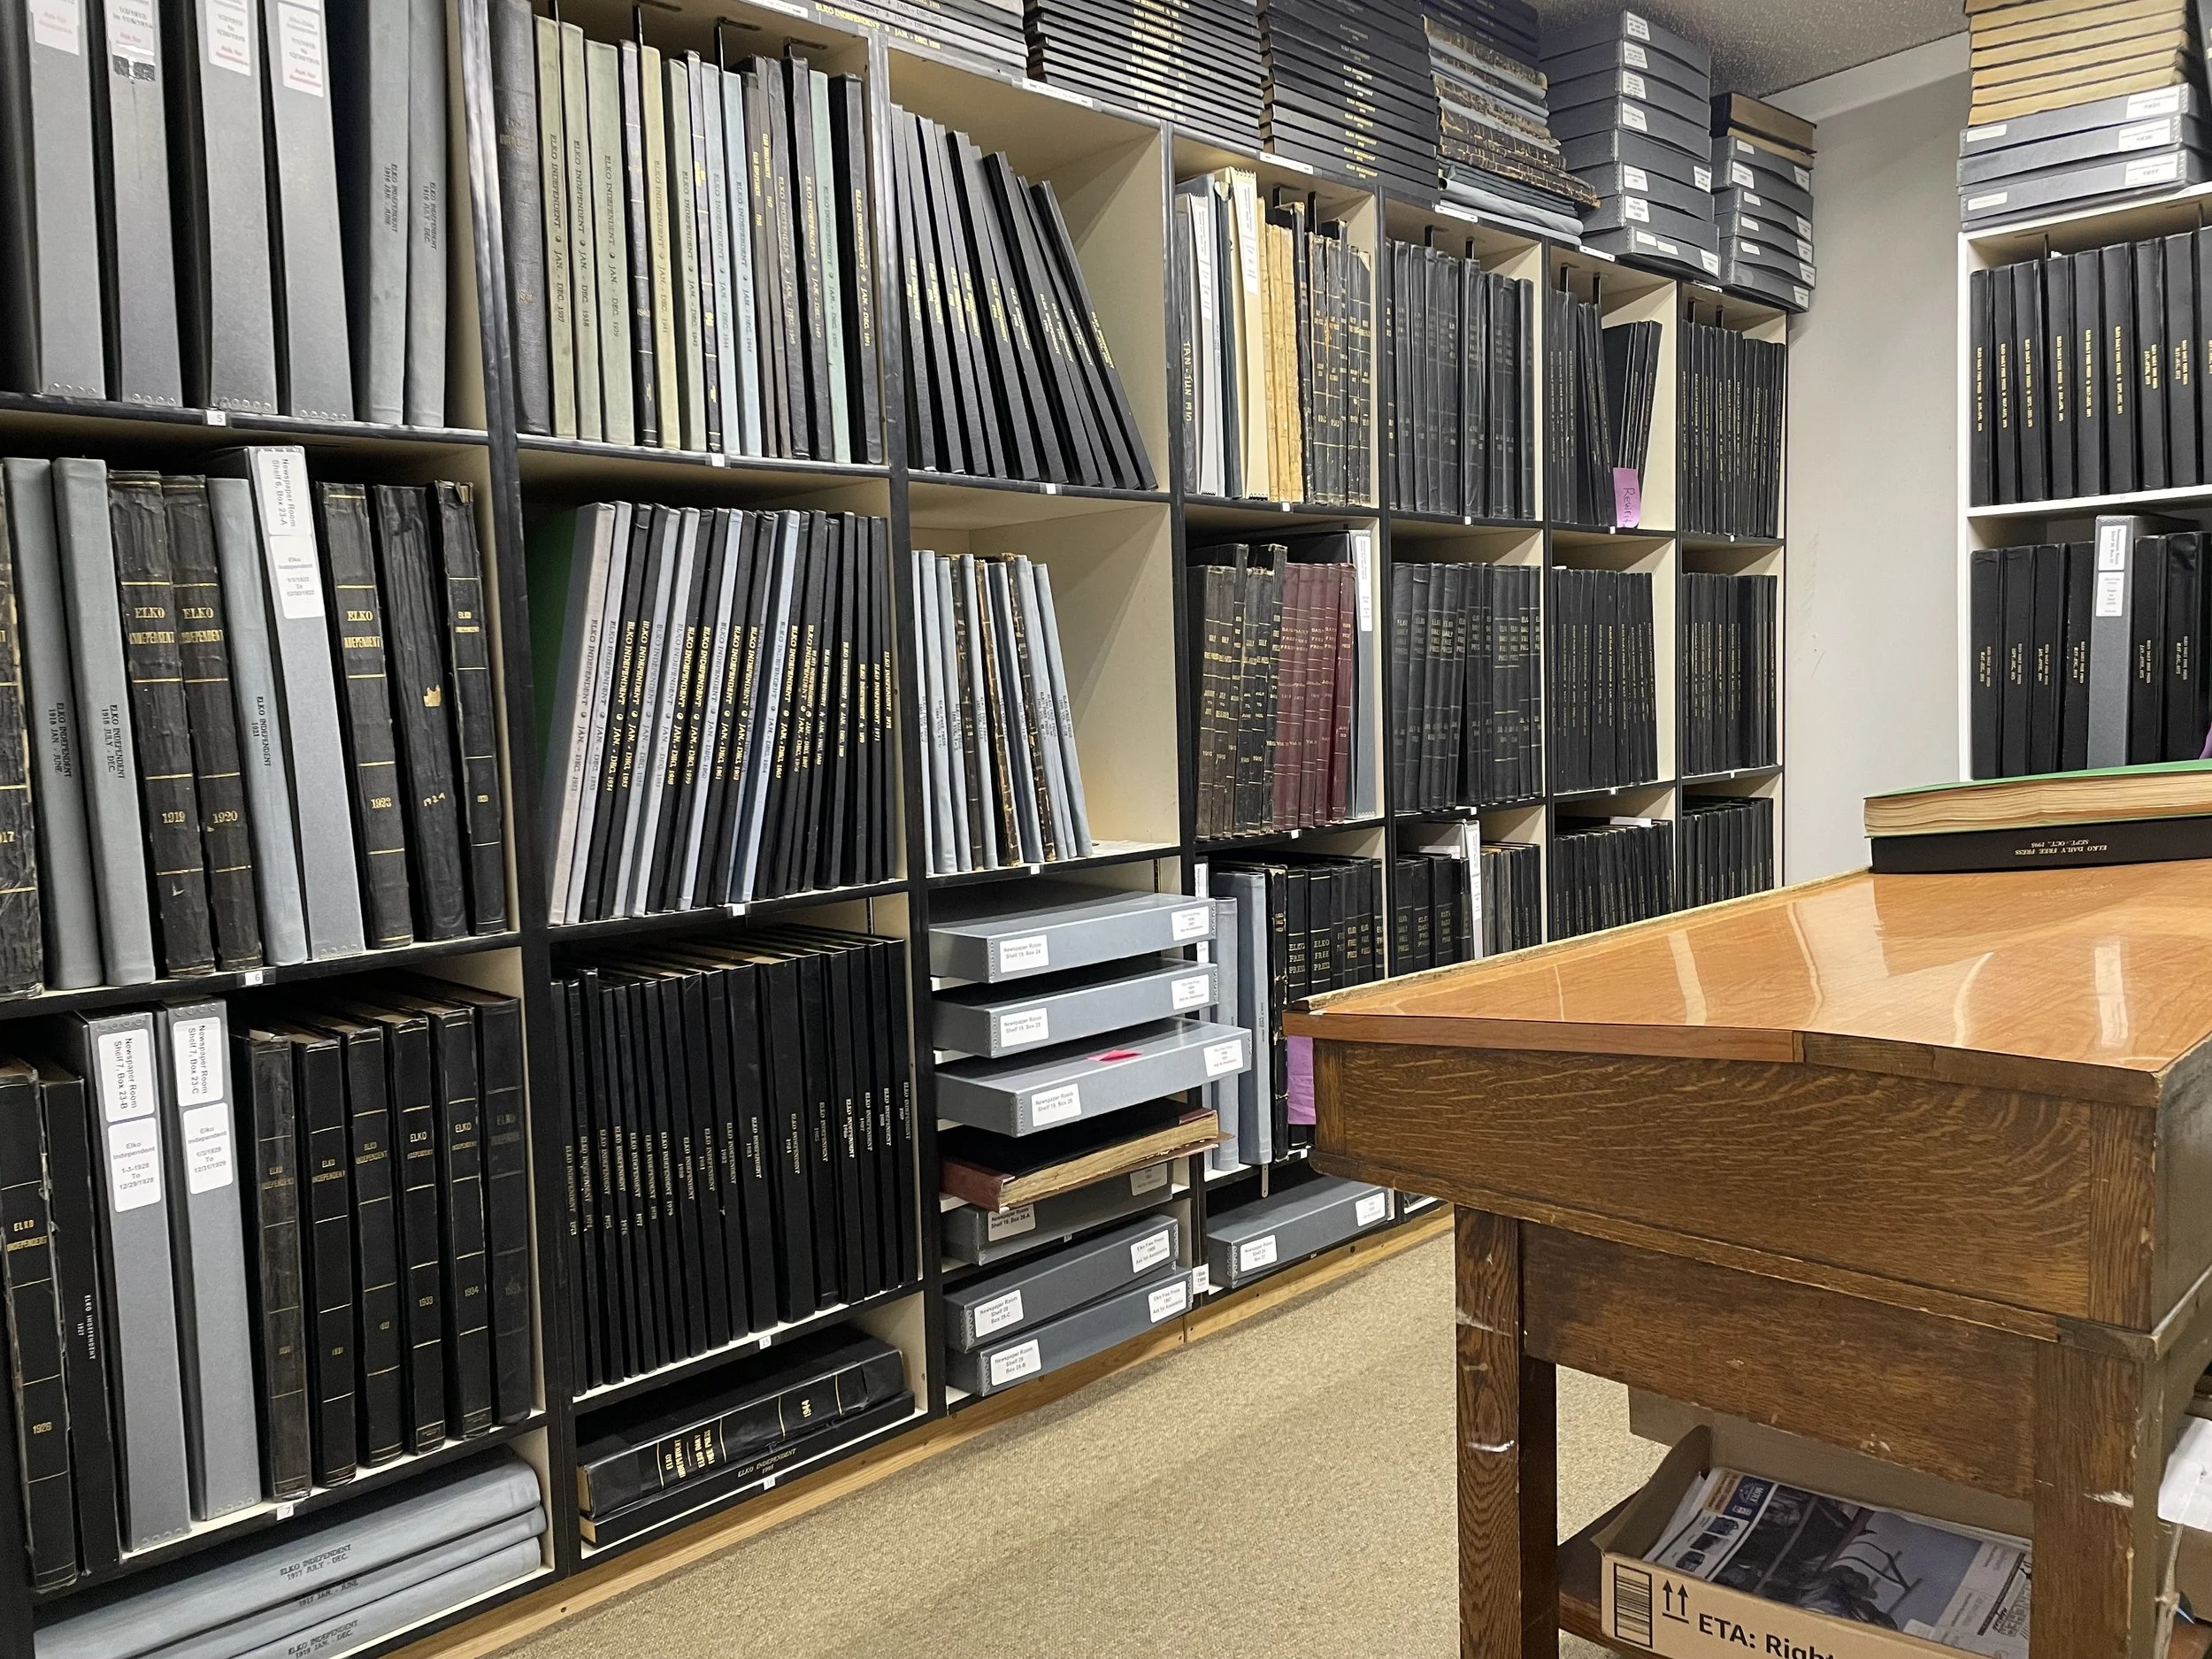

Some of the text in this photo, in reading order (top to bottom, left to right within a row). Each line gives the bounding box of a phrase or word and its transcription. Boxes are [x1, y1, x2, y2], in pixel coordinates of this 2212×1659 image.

[549, 134, 558, 159] ELKO
[552, 163, 561, 228] INDEPENDENT
[575, 169, 585, 234] INDEPENDENT
[606, 182, 615, 245] INDEPENDENT
[685, 199, 694, 259] INDEPENDENT
[716, 200, 725, 260] INDEPENDENT
[272, 459, 282, 480] Shelf
[275, 490, 284, 506] Box
[282, 458, 297, 527] Newspaper Room
[278, 508, 287, 526] 23-A
[134, 607, 165, 618] ELKO
[182, 607, 215, 619] ELKO
[347, 610, 373, 622] ELKO
[626, 621, 634, 644] ELKO
[702, 626, 710, 649] ELKO
[733, 626, 741, 648] ELKO
[618, 646, 632, 705] INDEPENDENT
[695, 650, 708, 707] INDEPENDENT
[726, 649, 739, 704] INDEPENDENT
[57, 703, 72, 778] ELKO INDEPENDENT
[104, 728, 112, 747] JULY
[109, 704, 126, 780] ELKO INDEPENDENT
[257, 696, 272, 767] ELKO INDEPENDENT
[53, 754, 62, 773] JUNE
[371, 796, 393, 809] 1923
[162, 810, 186, 824] 1919
[212, 810, 239, 824] 1920
[1313, 939, 1330, 948] ELKO
[1313, 962, 1330, 971] PRESS
[188, 1027, 197, 1048] Shelf
[113, 1041, 124, 1062] Shelf
[117, 1072, 126, 1088] Box
[125, 1038, 138, 1109] Newspaper Room
[119, 1091, 127, 1110] 23-B
[410, 1131, 427, 1143] ELKO
[455, 1122, 472, 1133] ELKO
[113, 1147, 156, 1159] Independent
[663, 1151, 672, 1195] INDEPENDENT
[706, 1148, 715, 1191] INDEPENDENT
[84, 1294, 96, 1360] ELKO INDEPENDENT
[738, 1466, 754, 1478] ELKO
[280, 1544, 352, 1576] ELKO INDEPENDENT
[305, 1562, 325, 1574] JULY
[288, 1619, 358, 1655] ELKO INDEPENDENT
[1699, 1612, 1756, 1648] ETA:
